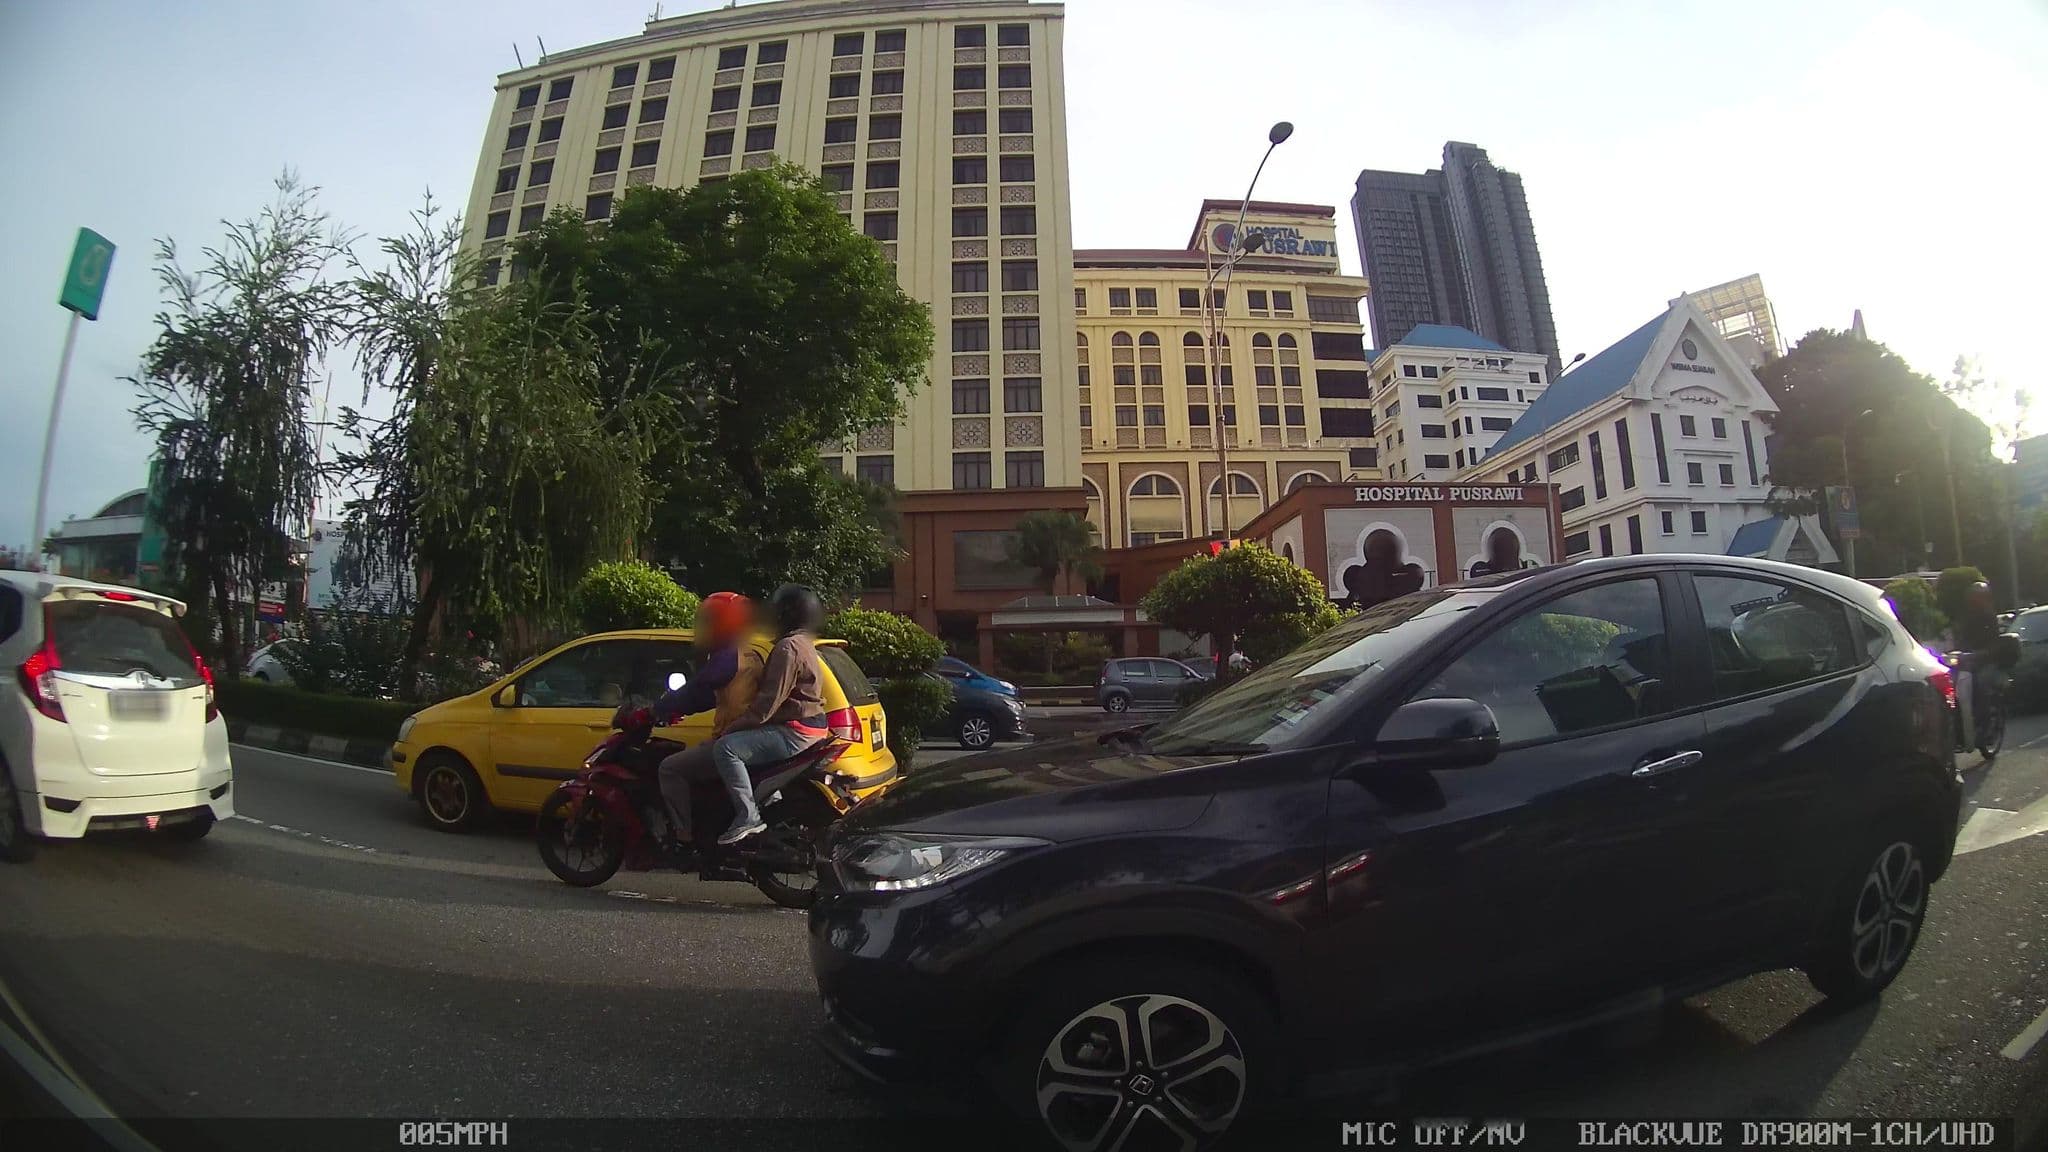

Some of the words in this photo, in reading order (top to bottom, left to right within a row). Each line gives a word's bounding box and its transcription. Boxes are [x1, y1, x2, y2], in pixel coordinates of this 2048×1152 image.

[1246, 226, 1304, 240] HOSPITAL
[1255, 238, 1337, 257] USRAWI
[1355, 487, 1444, 501] HOSPITAL
[1449, 487, 1523, 500] PUSRAWI
